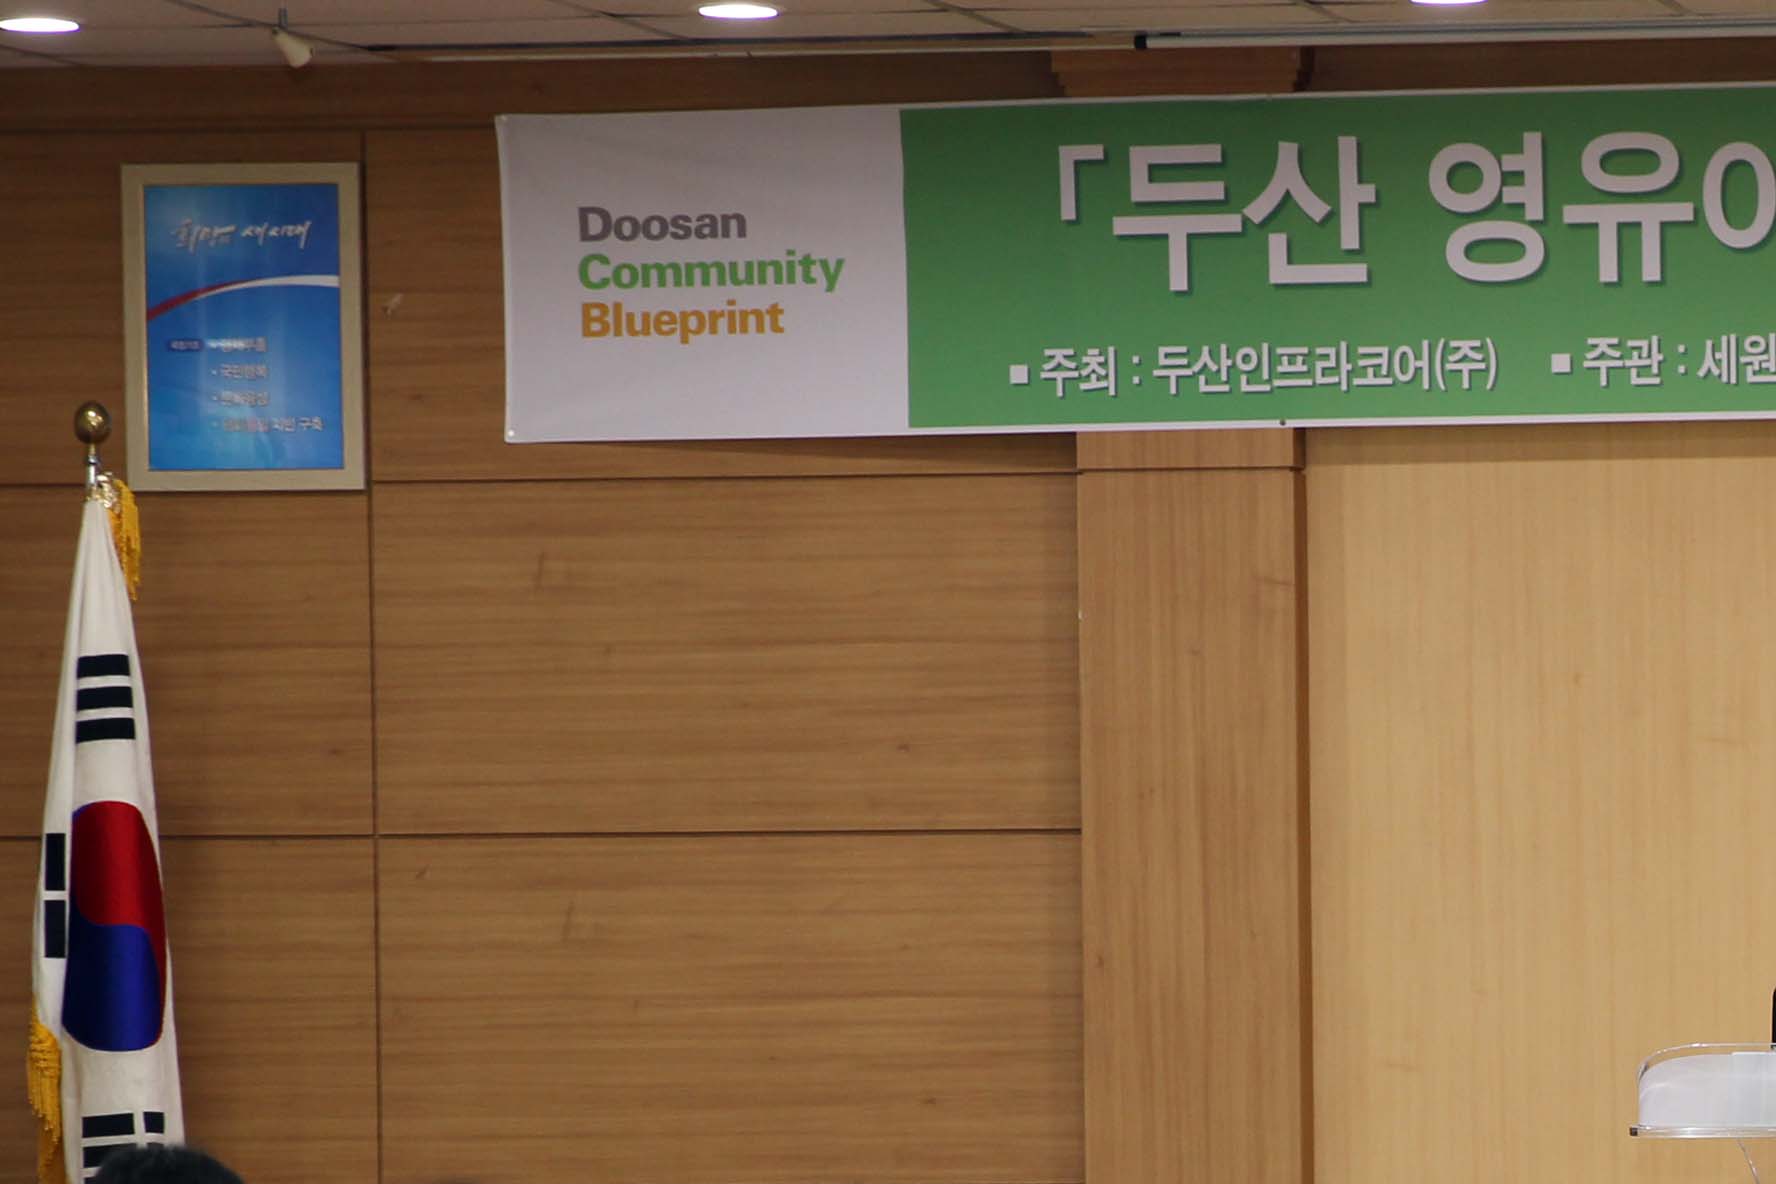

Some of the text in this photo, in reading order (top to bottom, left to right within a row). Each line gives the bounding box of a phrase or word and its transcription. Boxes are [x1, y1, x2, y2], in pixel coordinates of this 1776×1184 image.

[578, 206, 747, 242] Doosan
[578, 249, 846, 292] Community
[581, 299, 785, 345] Blueprint
[1040, 346, 1117, 396] 주최
[1152, 338, 1498, 394] 두산인프라코어(주)
[1583, 335, 1664, 386] 주관
